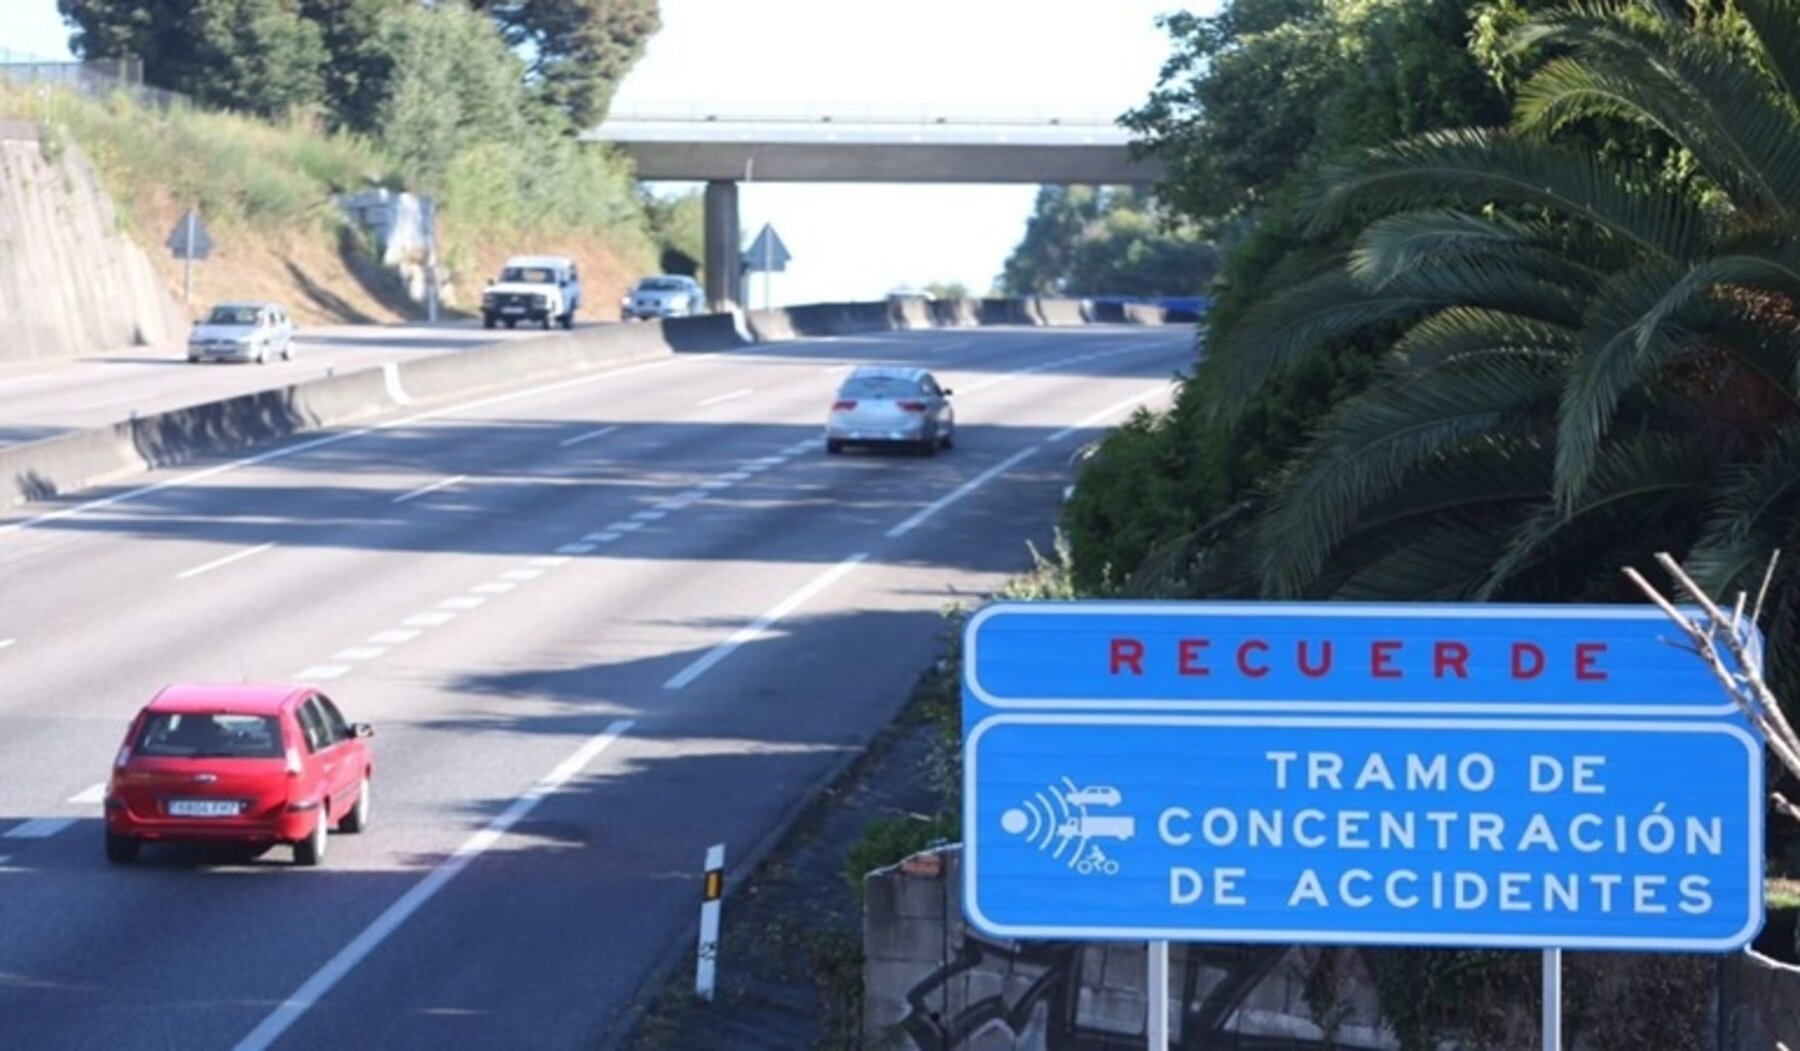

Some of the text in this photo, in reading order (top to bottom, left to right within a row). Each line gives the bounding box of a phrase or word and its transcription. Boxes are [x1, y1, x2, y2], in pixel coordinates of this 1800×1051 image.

[1110, 638, 1608, 681] RECUERDE
[1266, 752, 1606, 793] TRAMO DE
[1158, 803, 1722, 855] CONCENTRACIÓN
[1170, 868, 1713, 914] DE ACCIDENTES
